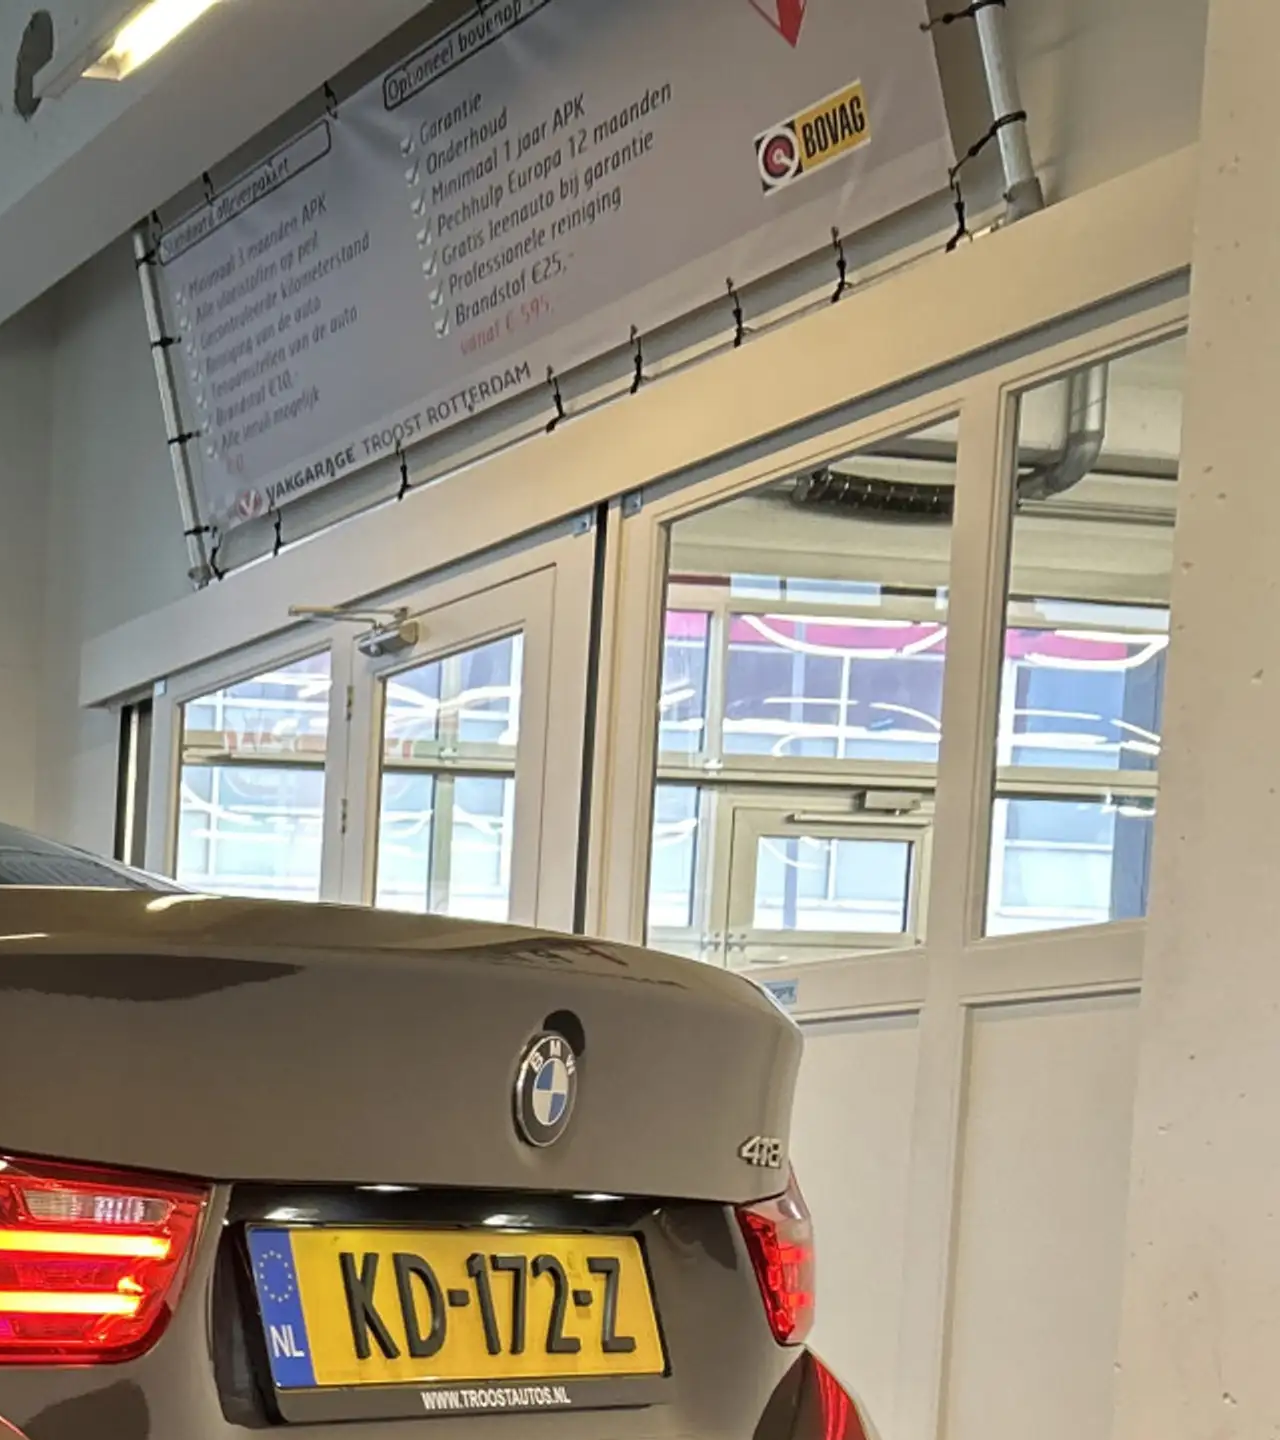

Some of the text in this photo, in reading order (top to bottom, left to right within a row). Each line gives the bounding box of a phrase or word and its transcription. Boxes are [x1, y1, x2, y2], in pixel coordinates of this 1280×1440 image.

[388, 43, 454, 101] Optioneel
[420, 91, 482, 145] Garantie
[426, 106, 508, 175] Onderhoud
[432, 93, 585, 205] Minimaal 1 jaar APK
[802, 95, 865, 159] BOVAG
[438, 82, 672, 236] Pechhulp Europa 12 maanden
[302, 193, 327, 227] APK
[442, 131, 654, 266] Gratis leenauto bij garantie
[281, 231, 370, 297] kilometerstand
[448, 186, 622, 296] Professionele reiniging
[294, 296, 322, 323] auto
[330, 305, 358, 335] auto
[456, 268, 527, 326] Brandstof
[265, 361, 531, 502] VAKGARAGE TROOST ROTTERDAM
[340, 1252, 636, 1359] KD-172-Z
[270, 1325, 305, 1358] NL
[421, 1386, 571, 1410] WWW.TROOSTAUTOS.NL
